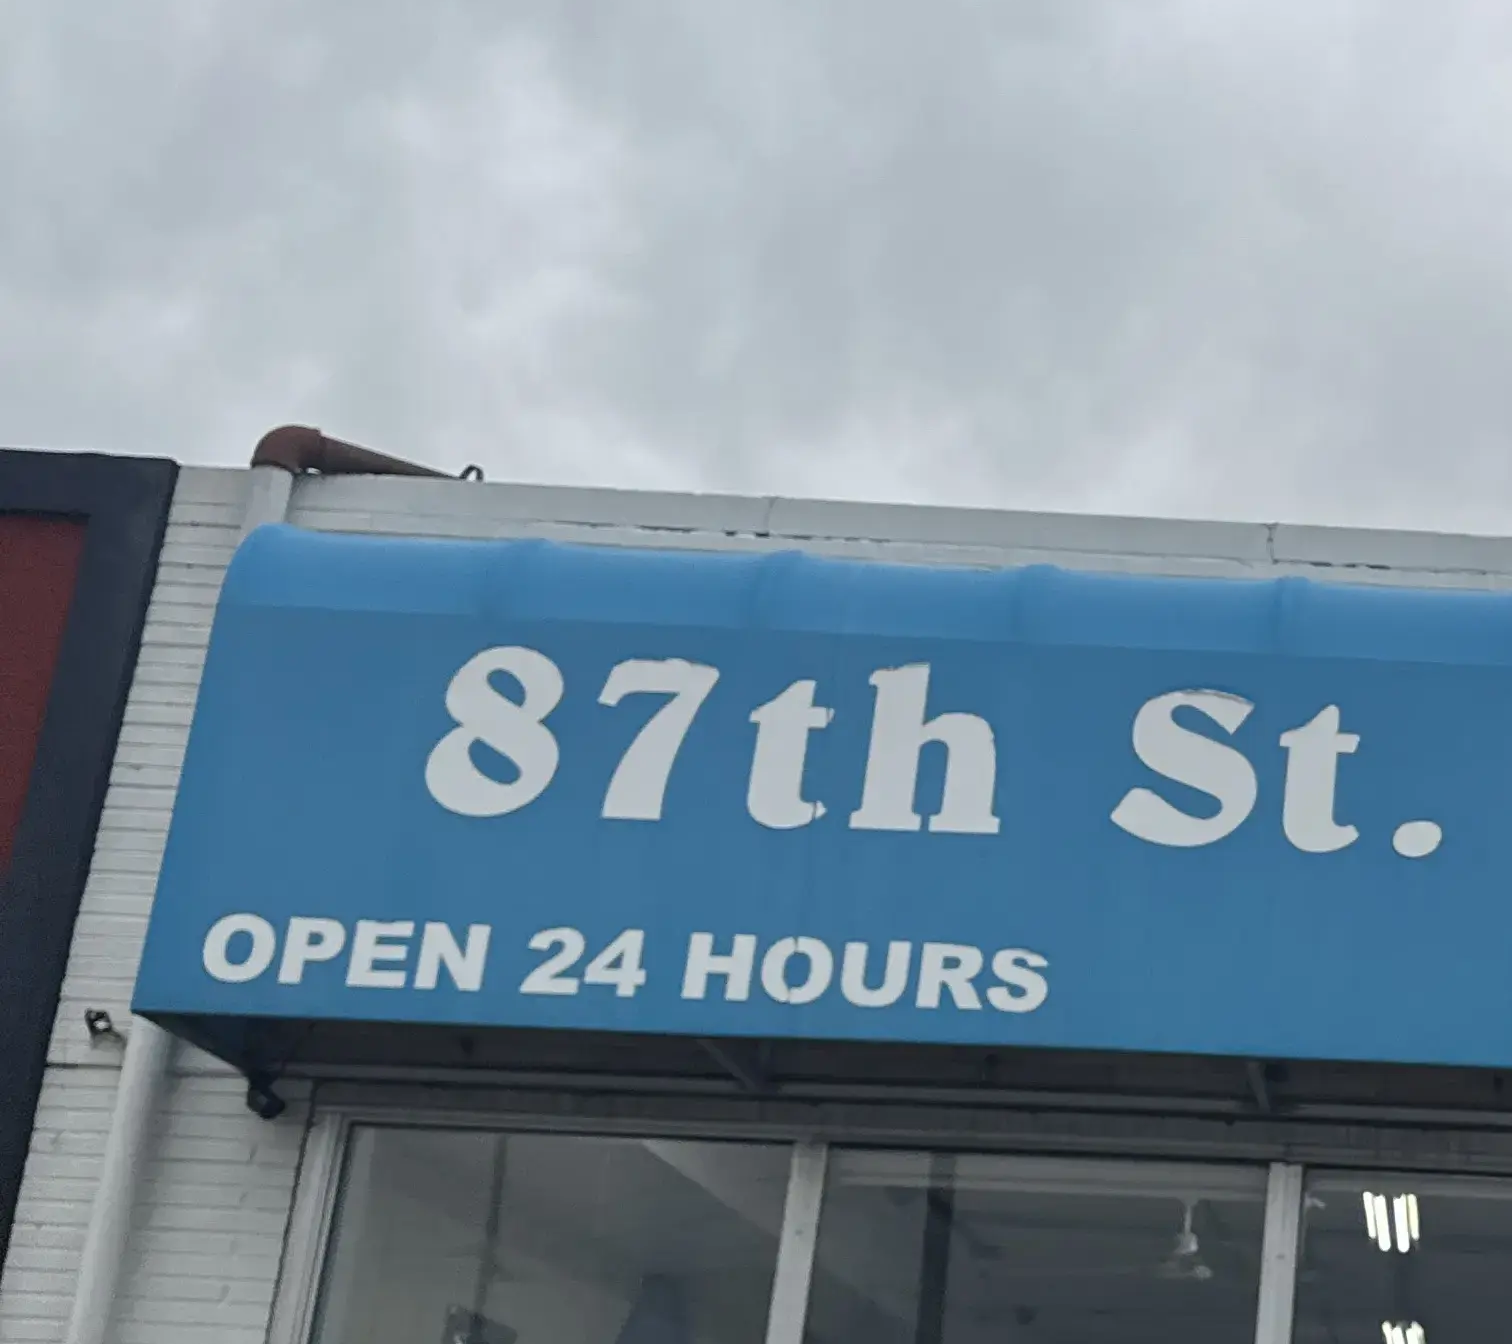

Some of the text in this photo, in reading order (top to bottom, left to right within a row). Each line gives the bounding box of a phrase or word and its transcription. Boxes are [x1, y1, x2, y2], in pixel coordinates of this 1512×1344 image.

[425, 646, 1000, 834] 87th
[1110, 689, 1442, 858] St.
[202, 913, 1049, 1013] OPEN 24 HOURS
